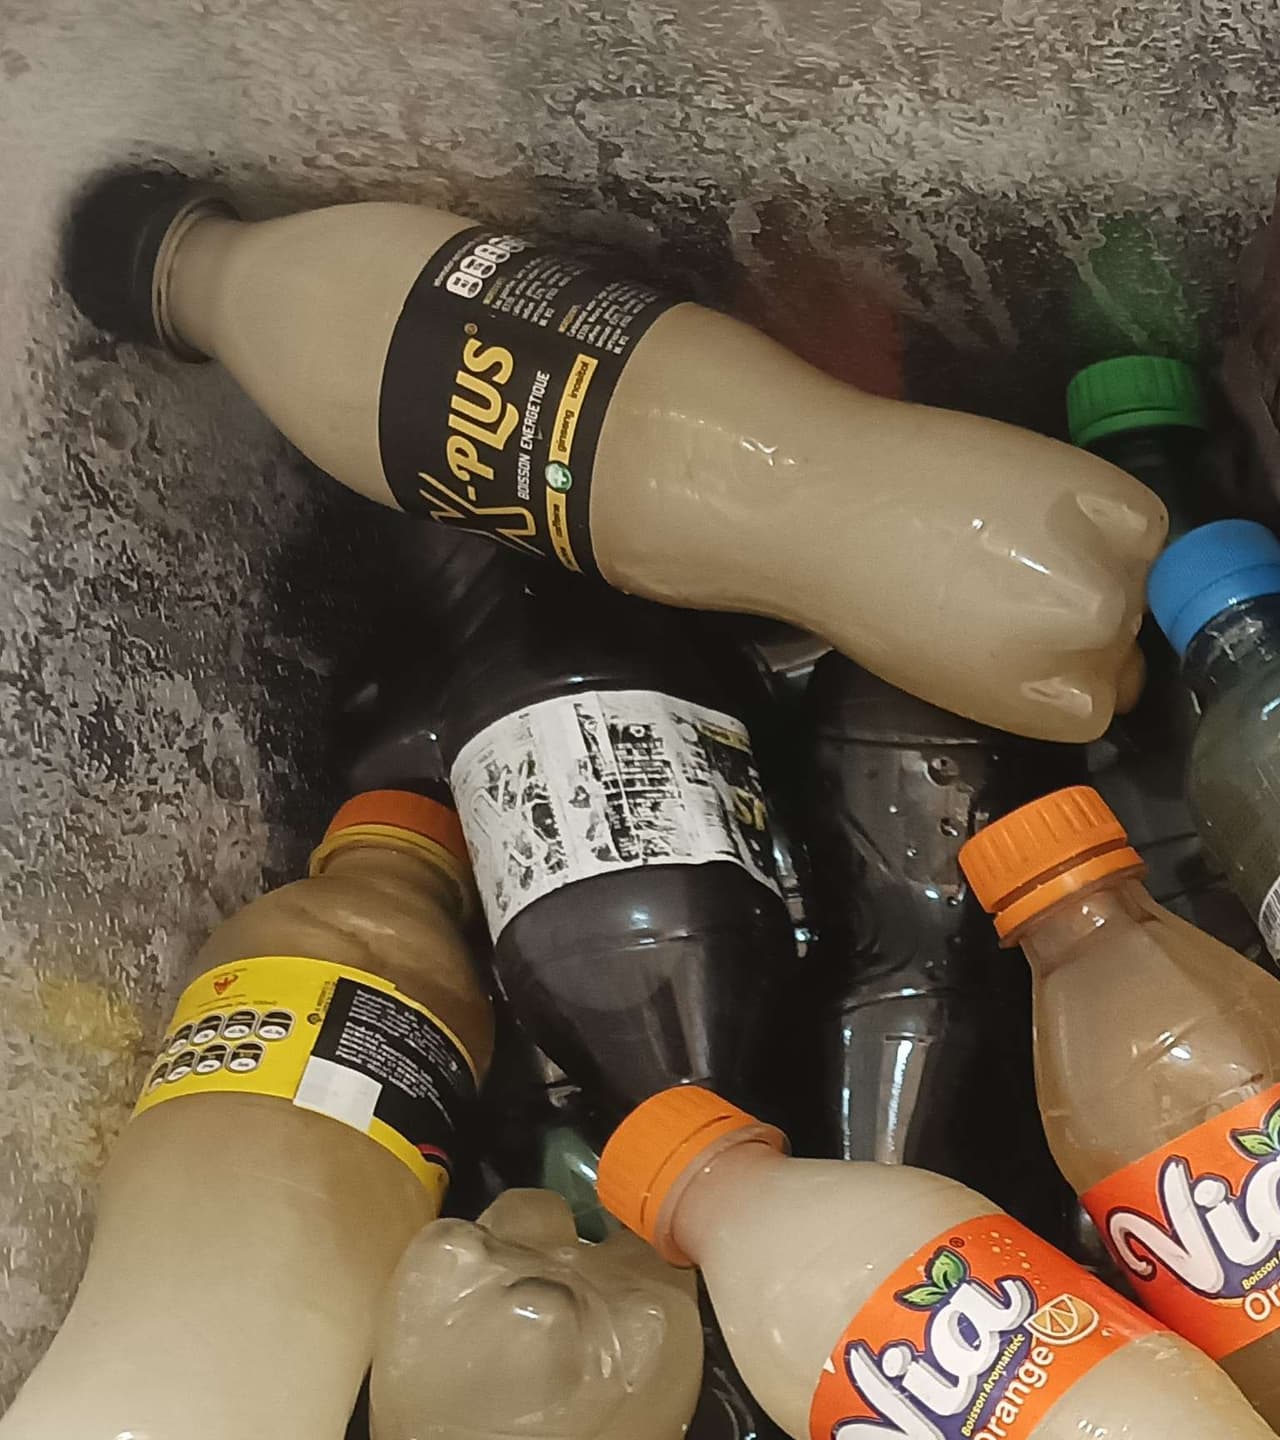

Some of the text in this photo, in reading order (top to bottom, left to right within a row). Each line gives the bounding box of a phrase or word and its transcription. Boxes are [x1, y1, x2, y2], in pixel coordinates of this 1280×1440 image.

[419, 336, 545, 557] X-PLUS
[507, 371, 550, 501] BOISSON ENERGETIQUE
[551, 409, 574, 453] ginseng
[1238, 1256, 1280, 1290] Boisson
[955, 1331, 1033, 1437] Boisson Aromatisée
